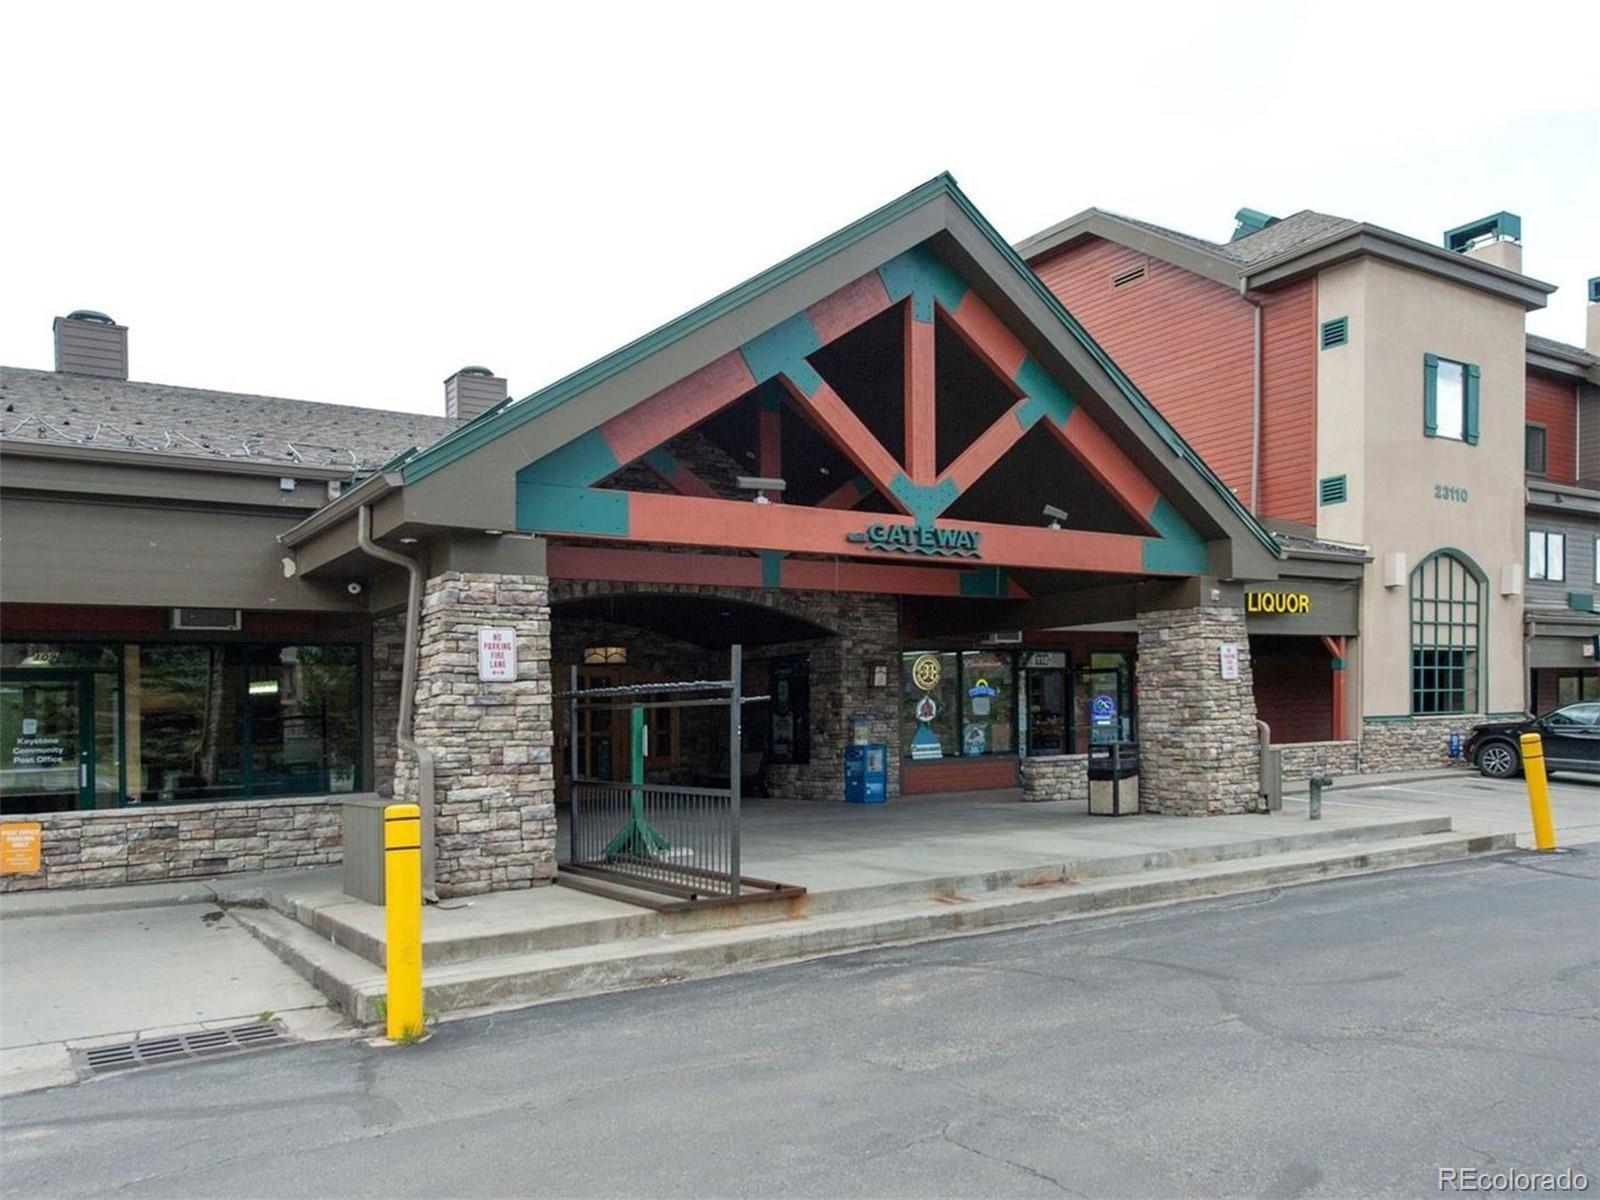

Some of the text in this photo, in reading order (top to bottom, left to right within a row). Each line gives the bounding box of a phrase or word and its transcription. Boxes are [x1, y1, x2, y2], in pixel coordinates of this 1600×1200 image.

[1434, 484, 1468, 503] 23110
[868, 523, 982, 549] GATEWAY
[1246, 592, 1311, 613] LIQUOR
[484, 642, 512, 651] PARKING
[490, 661, 505, 669] LANE
[17, 737, 60, 747] Keystone
[12, 746, 64, 756] Community
[13, 755, 63, 764] Post Office
